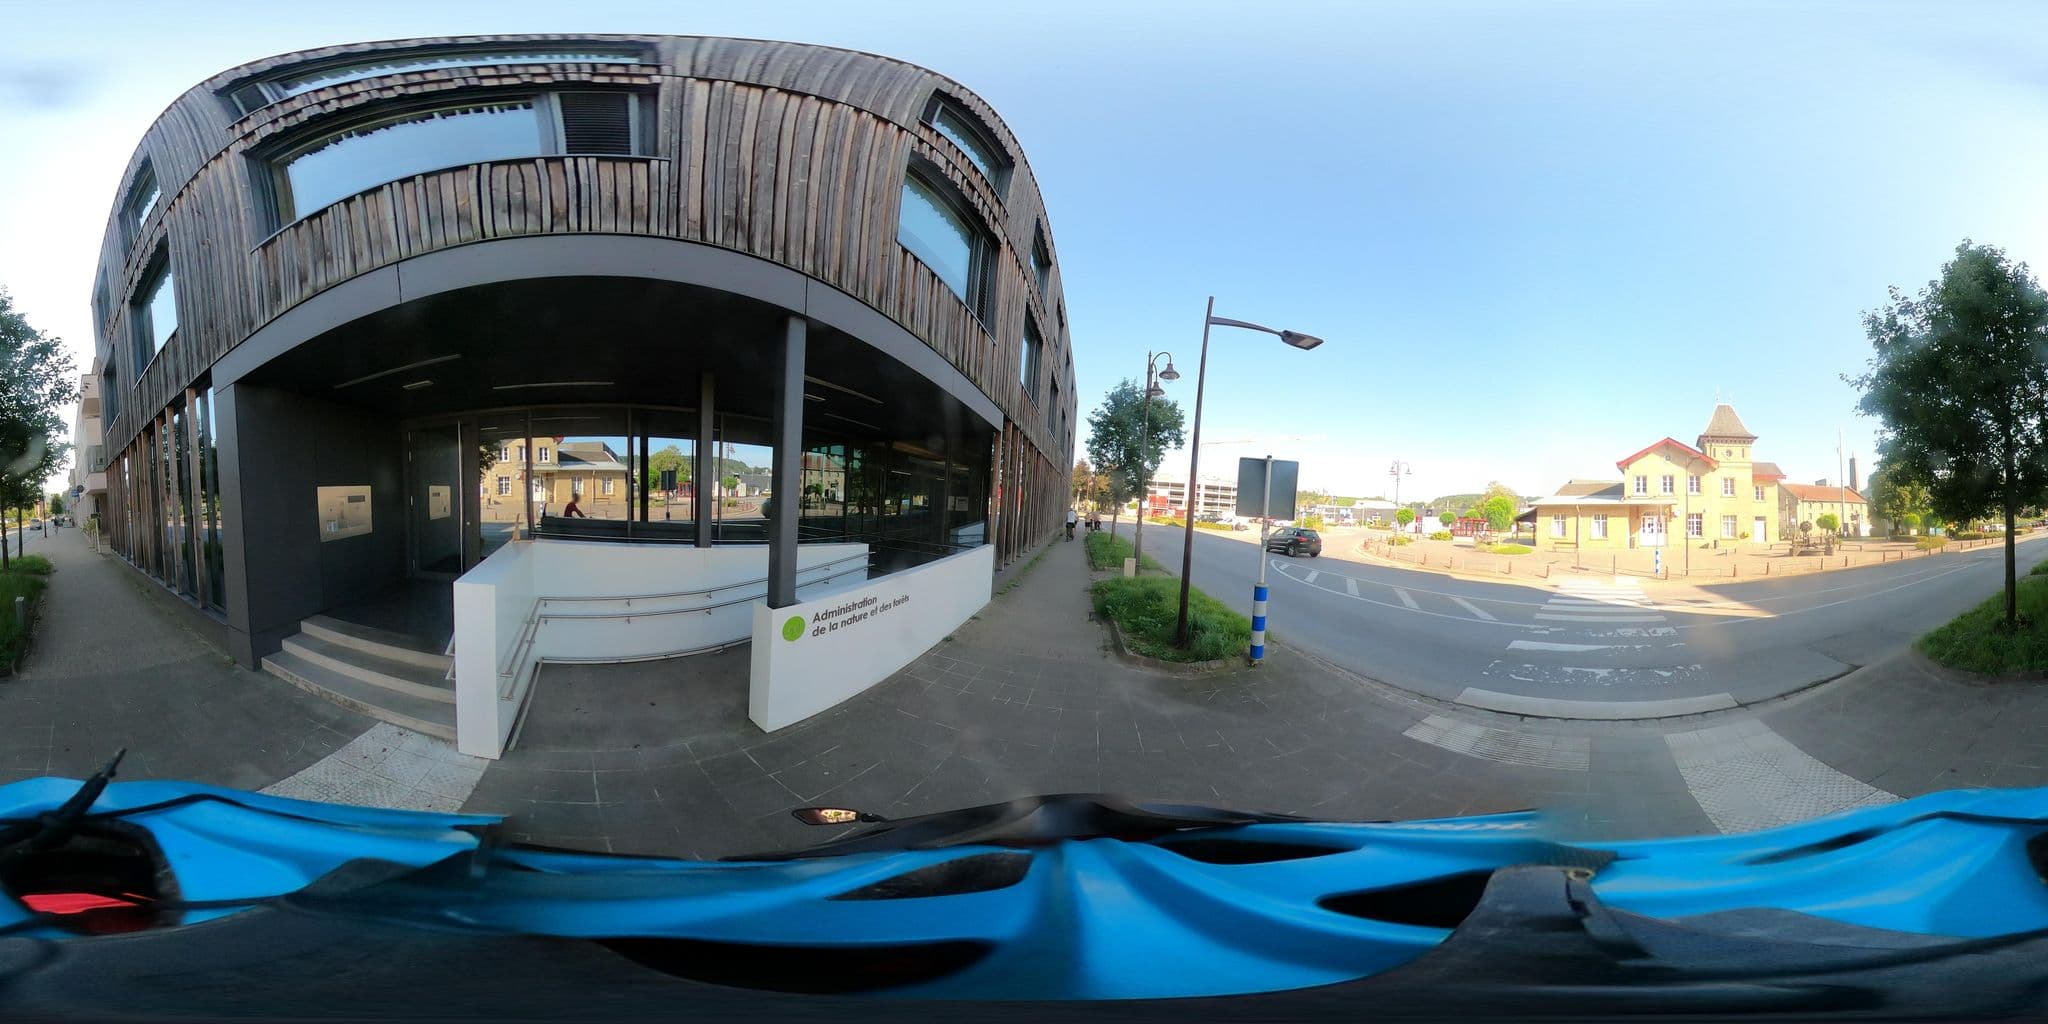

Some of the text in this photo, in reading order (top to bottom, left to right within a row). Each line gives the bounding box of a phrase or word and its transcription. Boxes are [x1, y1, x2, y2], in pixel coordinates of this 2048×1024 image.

[812, 596, 878, 623] Administration
[812, 594, 910, 637] de la nature et des forêts
